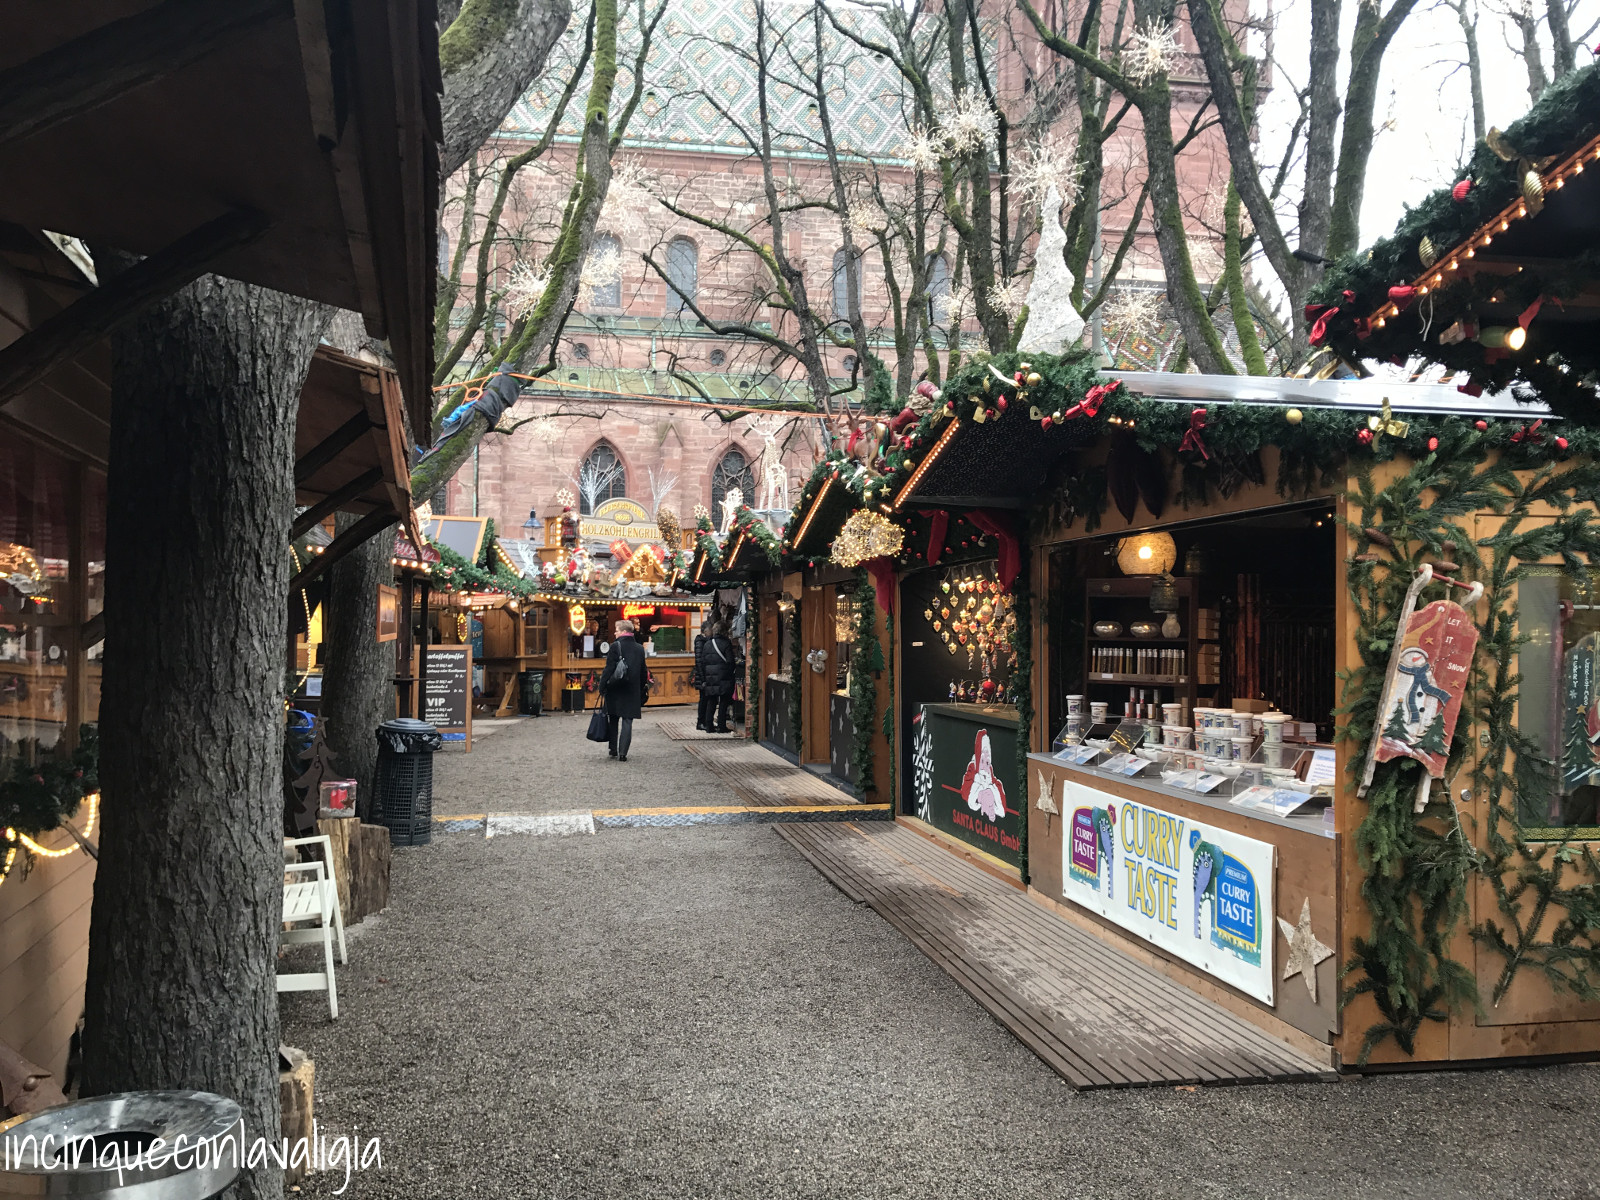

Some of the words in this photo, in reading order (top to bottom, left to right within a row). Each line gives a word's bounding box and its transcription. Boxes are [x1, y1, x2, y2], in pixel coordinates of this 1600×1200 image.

[1447, 617, 1461, 627] LET
[1445, 635, 1454, 644] IT
[1447, 662, 1466, 673] SNOW
[1583, 657, 1591, 706] CHRISTMAS
[426, 697, 446, 707] VIP
[952, 809, 974, 830] SANTA
[975, 819, 999, 843] CLAUS
[1075, 826, 1094, 843] CURRY
[1121, 802, 1184, 873] CURRY
[1073, 838, 1095, 861] TASTE
[1225, 867, 1247, 882] PREMIUM
[1124, 857, 1178, 931] TASTE
[1221, 882, 1251, 904] CURRY
[1219, 897, 1253, 927] TASTE
